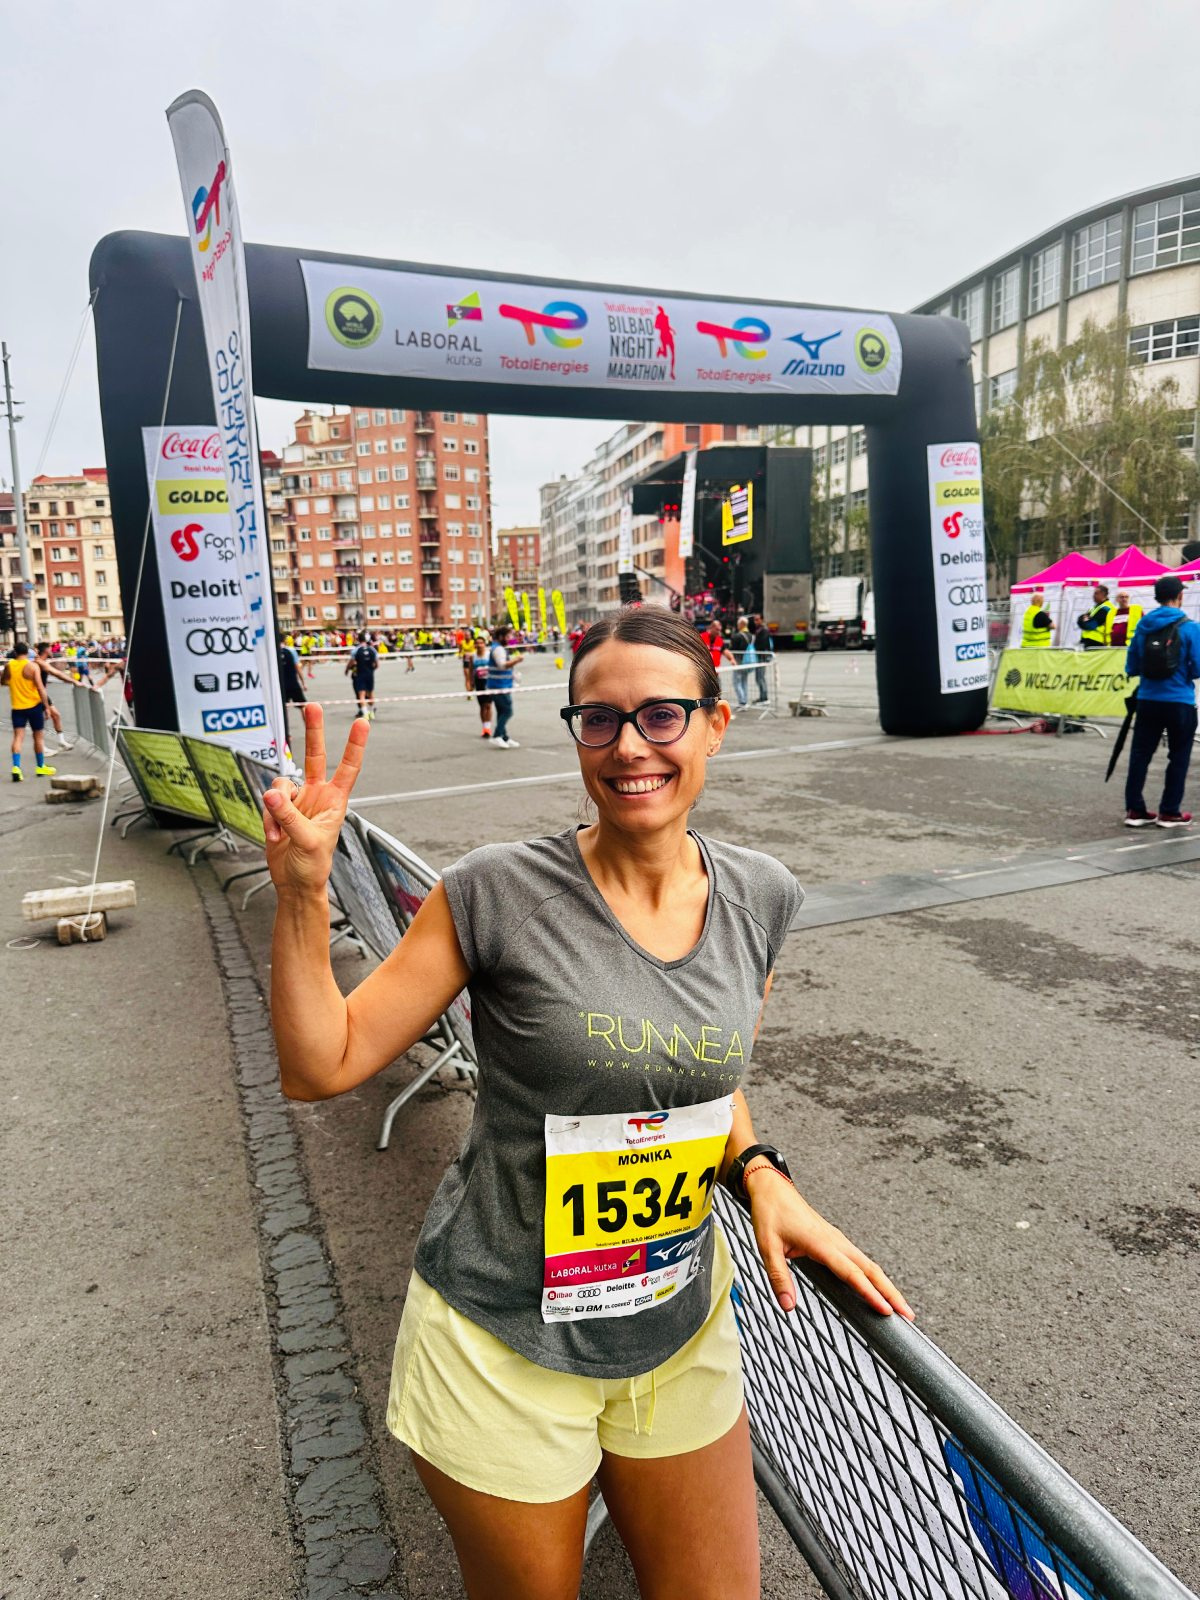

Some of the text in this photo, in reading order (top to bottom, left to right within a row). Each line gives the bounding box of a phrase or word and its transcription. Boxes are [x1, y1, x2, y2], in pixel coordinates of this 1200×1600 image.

[608, 315, 654, 336] BILBAO
[395, 329, 483, 352] LABORAL
[610, 335, 655, 359] NIGHT
[446, 353, 482, 367] kutxa
[499, 356, 589, 375] TotalEnergies
[607, 363, 667, 380] MARATHON
[696, 368, 772, 384] TotalEnergies
[162, 432, 222, 459] Coca-Co
[169, 490, 228, 504] GOLDC
[947, 679, 960, 688] EL
[1025, 672, 1061, 689] WORLD
[205, 708, 265, 731] GOYA
[588, 1013, 743, 1064] RUNNEA
[625, 1133, 666, 1145] TotalEnergies
[618, 1149, 672, 1166] MONIKA
[562, 1166, 716, 1236] 15341
[551, 1261, 617, 1279] LABORAL kutxa
[586, 1304, 603, 1312] BM
